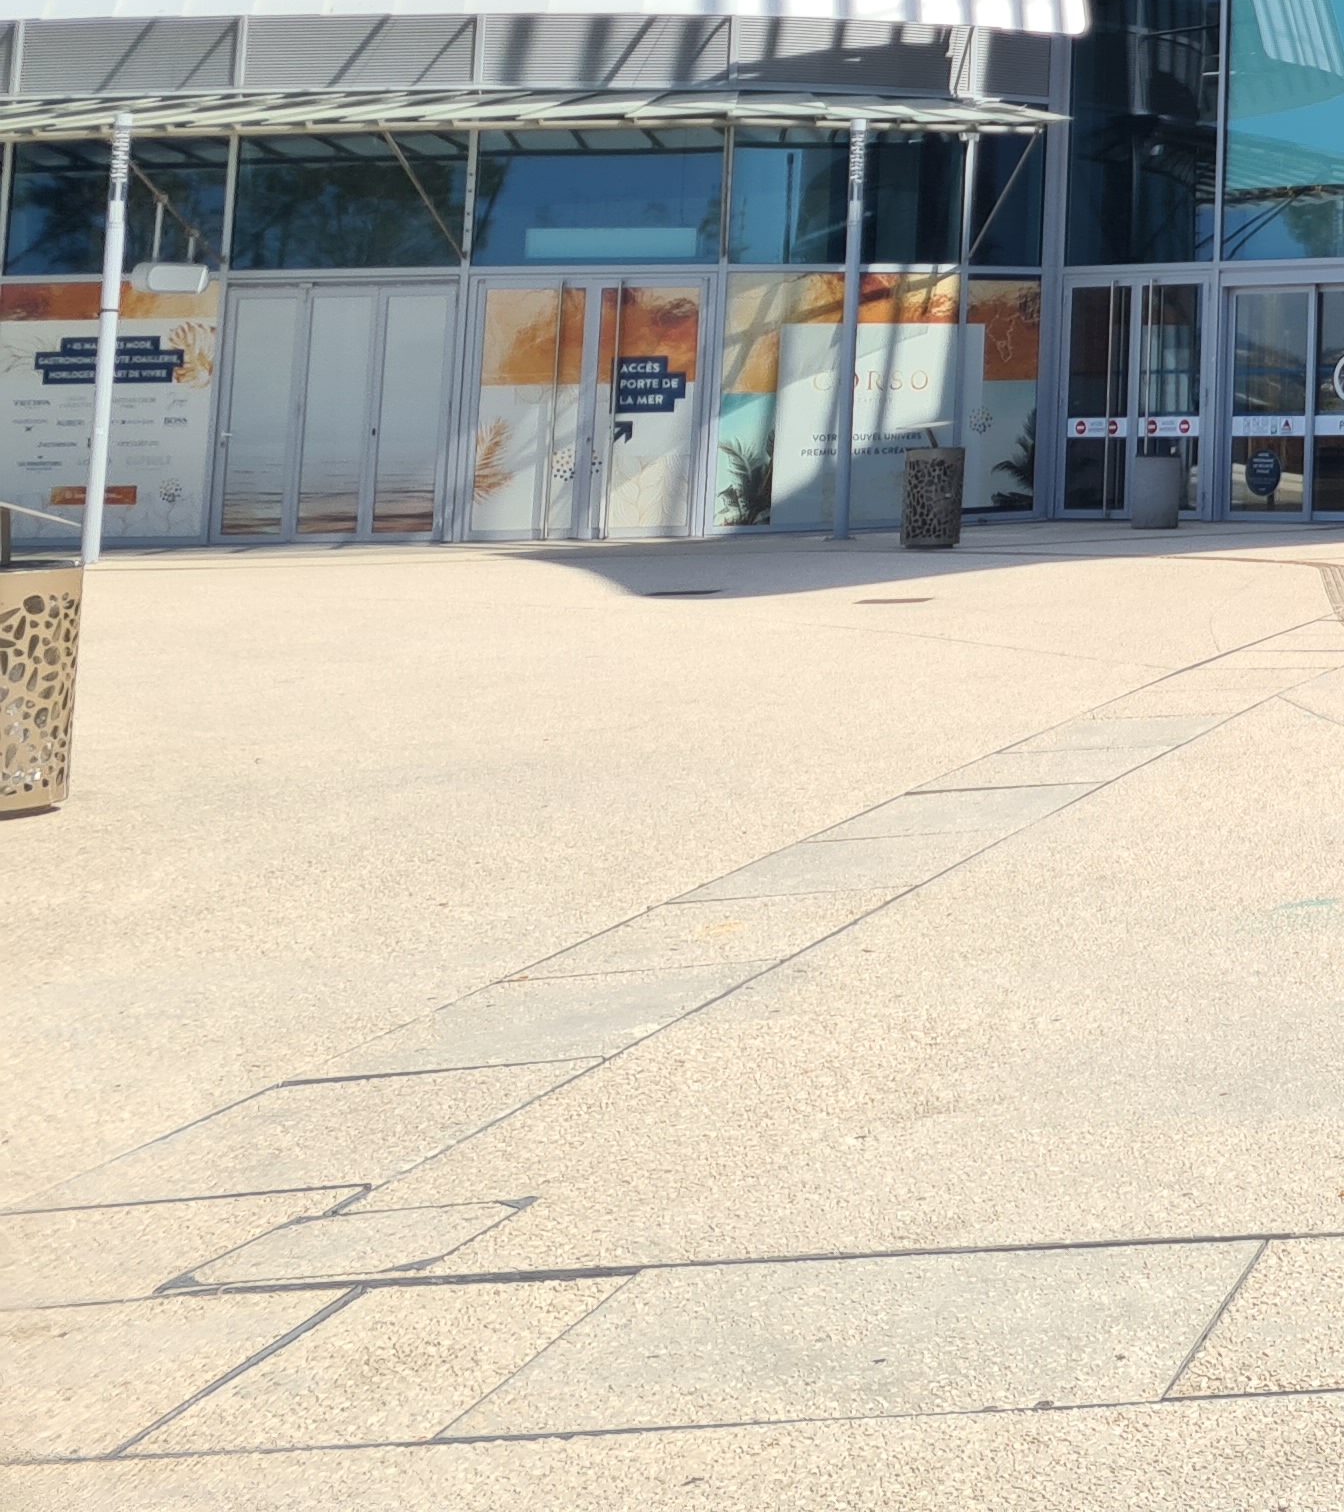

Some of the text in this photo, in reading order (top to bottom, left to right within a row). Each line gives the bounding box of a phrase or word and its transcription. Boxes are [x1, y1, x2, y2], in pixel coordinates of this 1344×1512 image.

[620, 360, 661, 373] ACCÈS
[619, 378, 680, 390] PORTE DE
[812, 370, 929, 392] CRSO
[619, 394, 664, 405] LA MER
[812, 434, 838, 442] VOTR
[884, 432, 922, 441] UNIVERS
